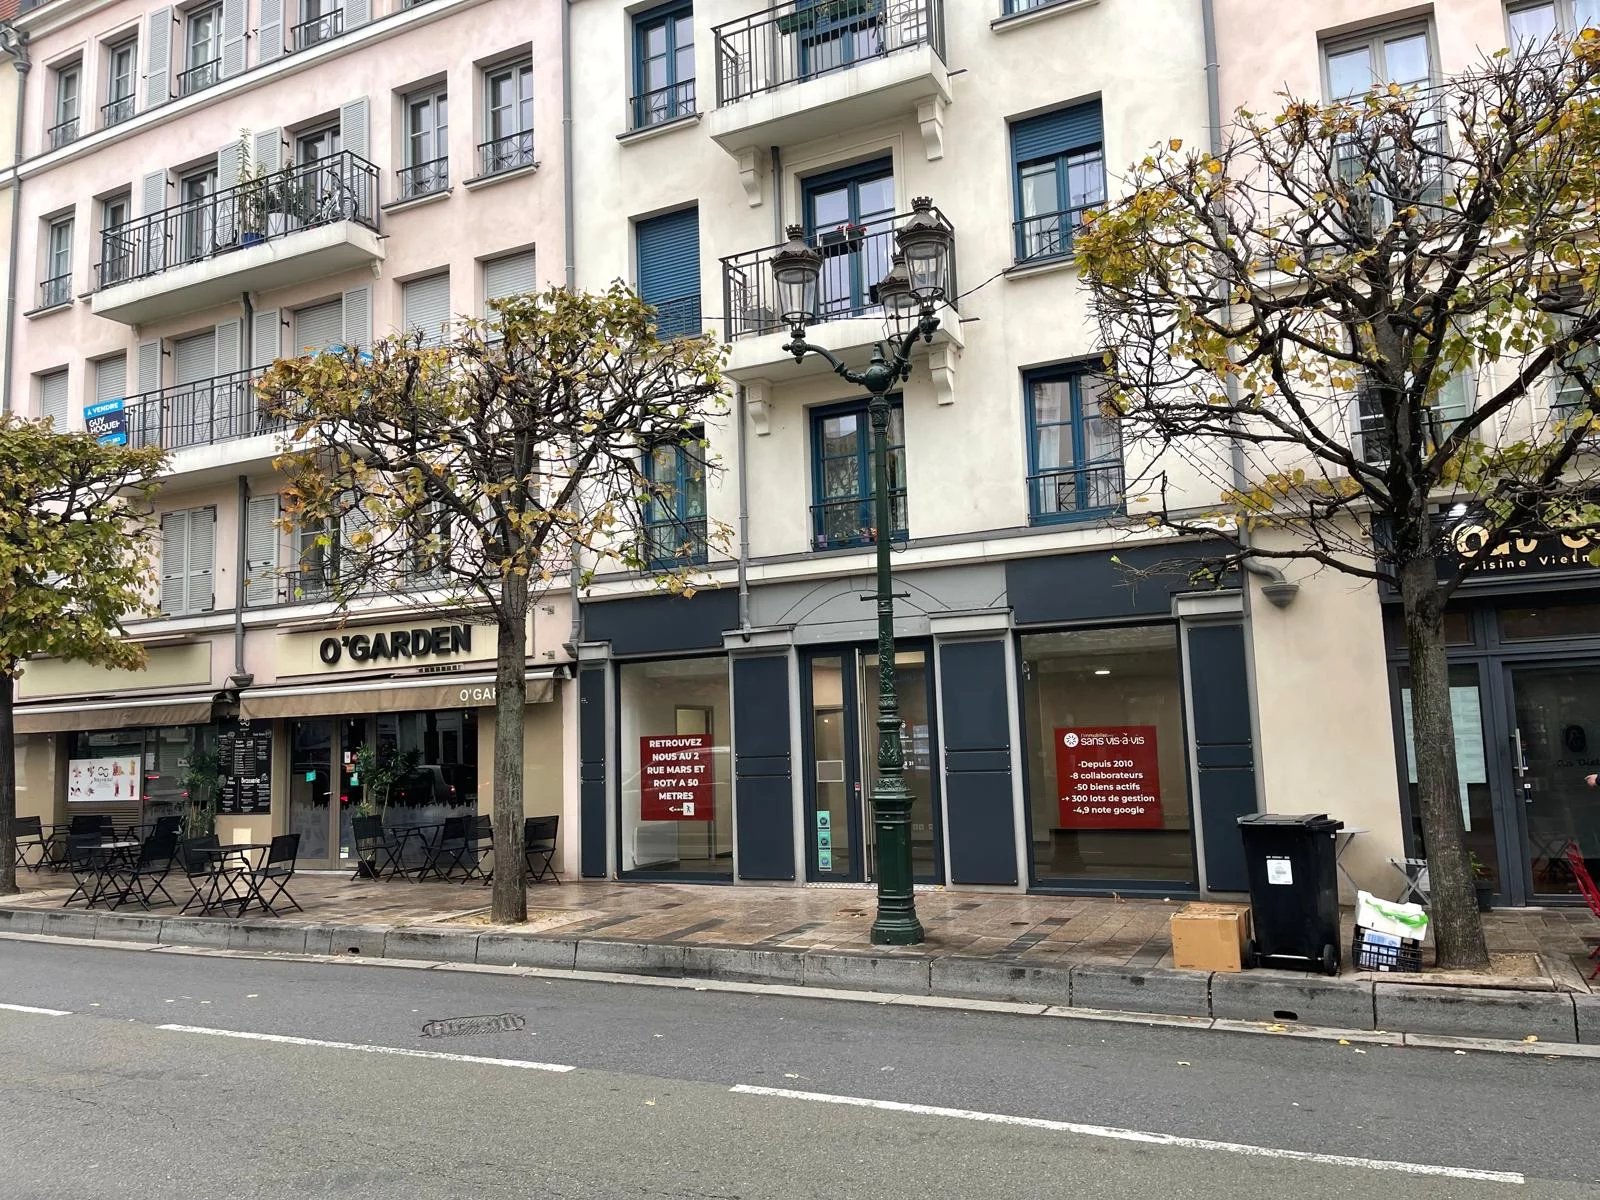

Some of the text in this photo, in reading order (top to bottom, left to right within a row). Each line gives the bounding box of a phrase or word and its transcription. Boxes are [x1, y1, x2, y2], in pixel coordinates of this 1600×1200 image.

[93, 402, 119, 414] VENDRE
[89, 416, 105, 428] GUY
[320, 624, 472, 664] O'GARDEN
[649, 738, 702, 748] RETROUVEZ
[1080, 737, 1105, 746] sans
[652, 752, 700, 761] NOUS AU 2
[1078, 760, 1134, 769] -Depuis 2010
[647, 765, 705, 775] RUE MARS ET
[1080, 771, 1144, 779] collaborateurs
[653, 778, 699, 787] ROTY A 50
[1074, 783, 1141, 791] -50 biens actifs
[658, 792, 694, 800] METRES
[1071, 795, 1088, 803] 300
[1089, 795, 1106, 803] lots
[1107, 794, 1120, 802] de
[1121, 794, 1155, 804] gestion
[1073, 806, 1090, 815] -4,9
[1113, 806, 1145, 815] google
